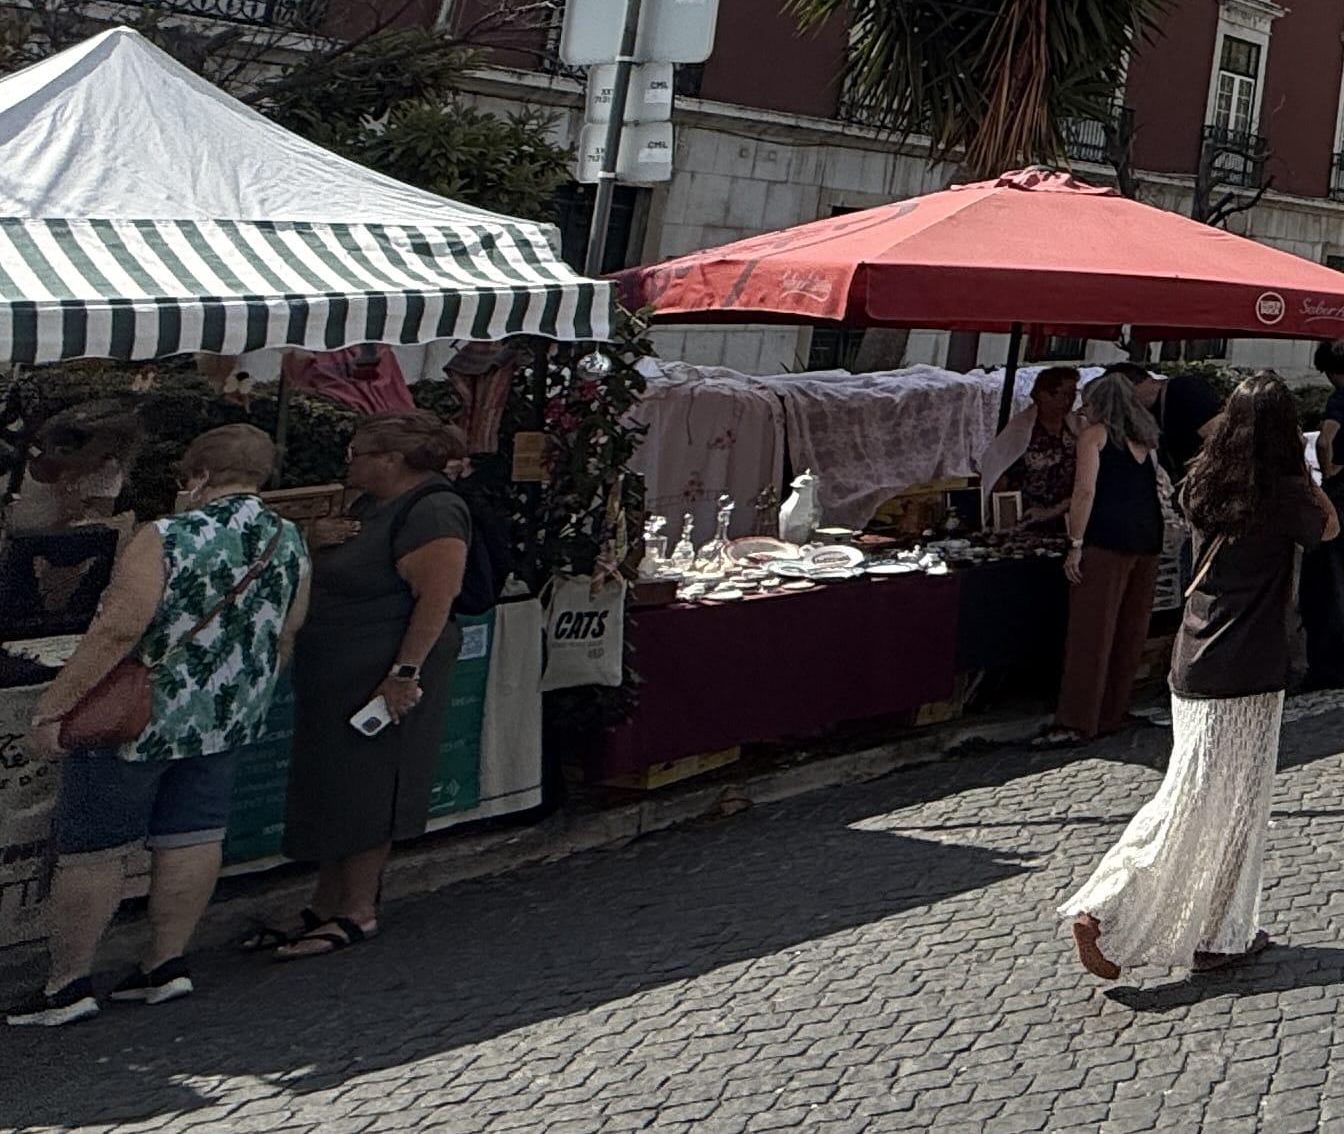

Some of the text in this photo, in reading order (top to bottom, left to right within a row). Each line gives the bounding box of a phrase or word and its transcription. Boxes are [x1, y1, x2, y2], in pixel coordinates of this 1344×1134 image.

[650, 81, 668, 89] CML
[648, 141, 668, 149] CML
[554, 610, 610, 639] CATS
